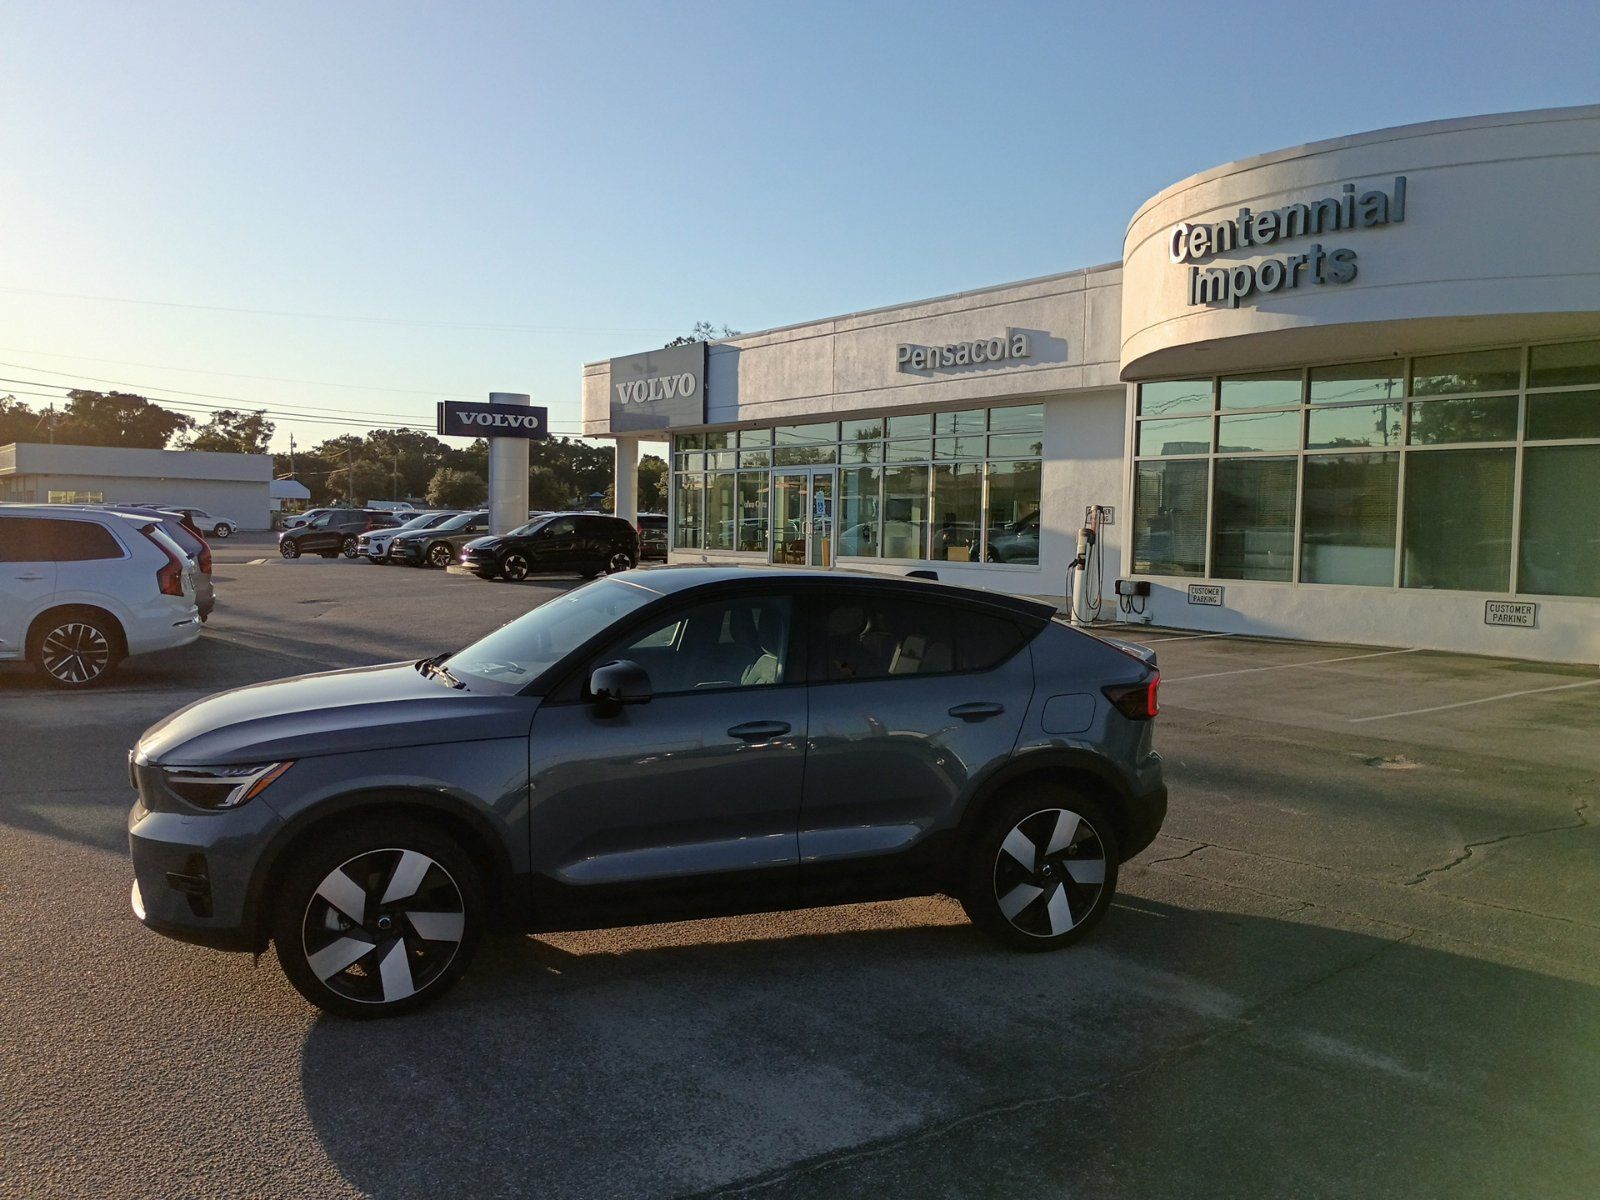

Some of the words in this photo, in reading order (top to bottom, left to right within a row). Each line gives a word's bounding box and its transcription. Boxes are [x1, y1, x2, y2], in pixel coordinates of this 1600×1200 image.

[1169, 176, 1407, 264] Centennial
[1187, 244, 1357, 308] Imports
[896, 327, 1030, 373] Pensacola
[616, 372, 696, 404] VOLVO
[456, 412, 539, 429] VOLVO
[1191, 586, 1220, 595] CUSTOMER
[1193, 595, 1217, 603] PARKING
[1490, 604, 1532, 614] CUSTOMER
[1492, 613, 1527, 624] PARKING
